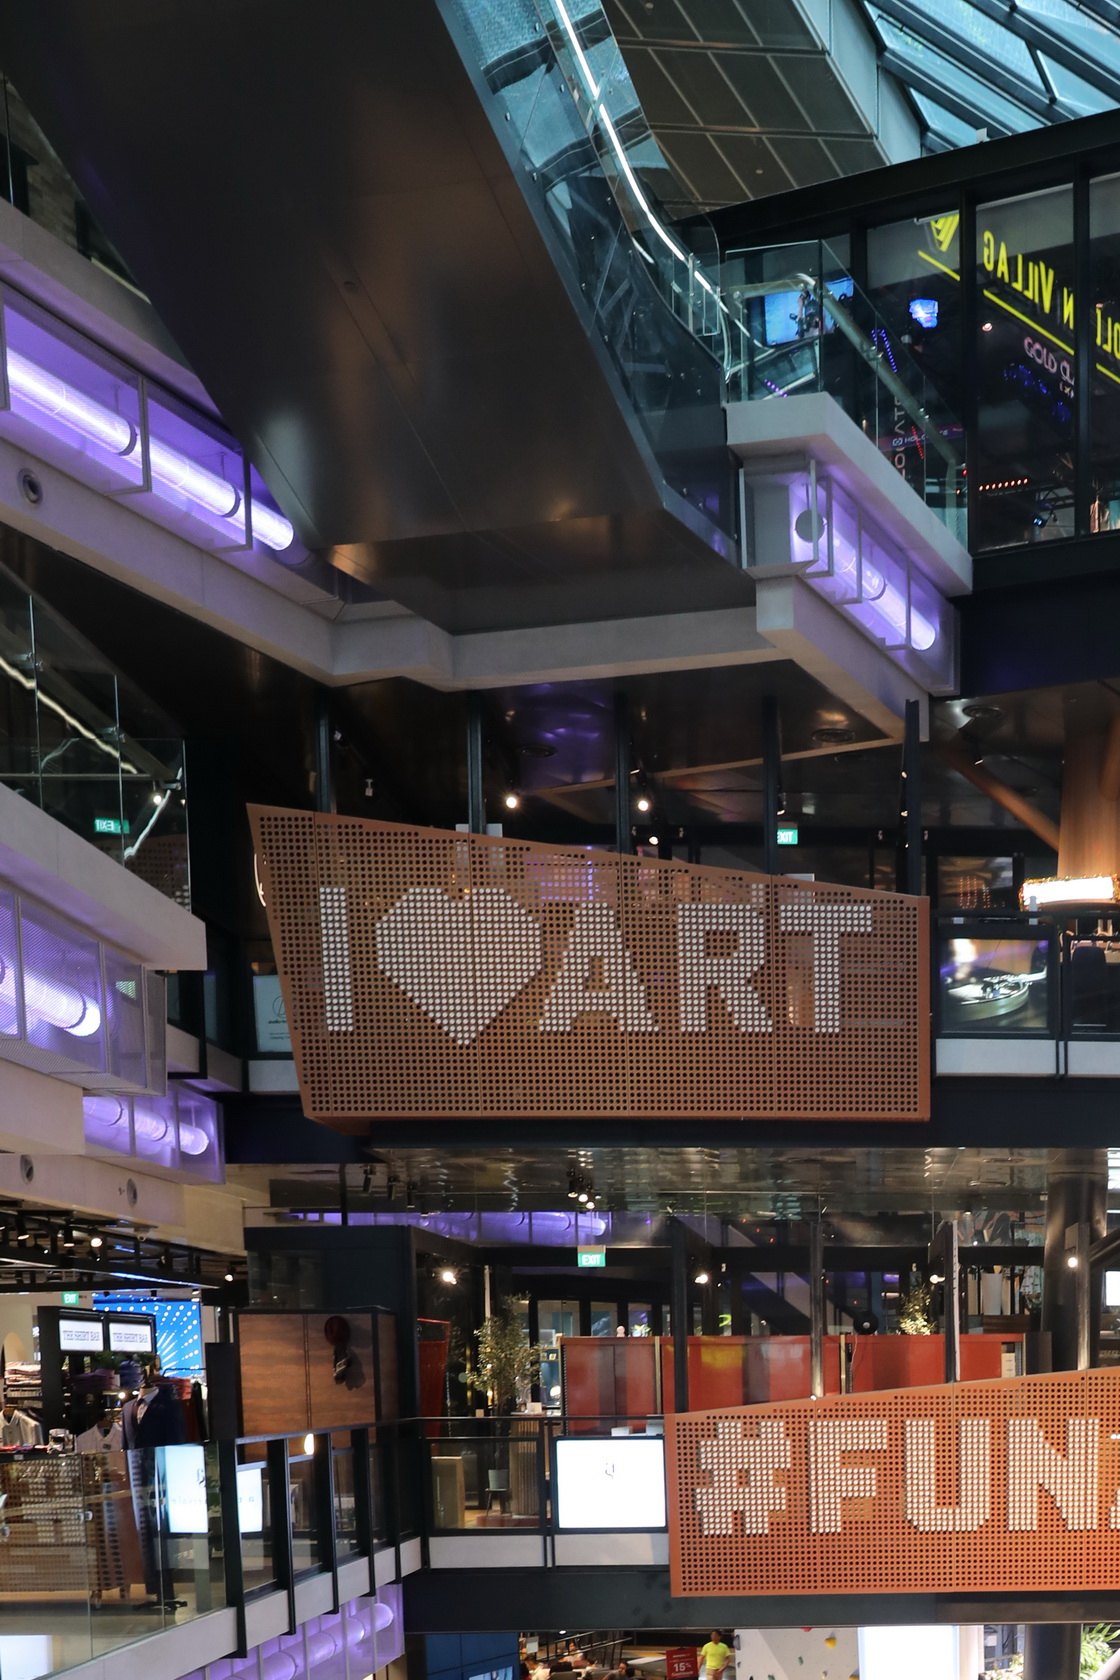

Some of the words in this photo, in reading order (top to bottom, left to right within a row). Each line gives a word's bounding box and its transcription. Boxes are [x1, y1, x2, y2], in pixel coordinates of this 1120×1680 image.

[319, 886, 355, 1032] I
[538, 900, 873, 1036] ART
[581, 1254, 602, 1265] EXIT
